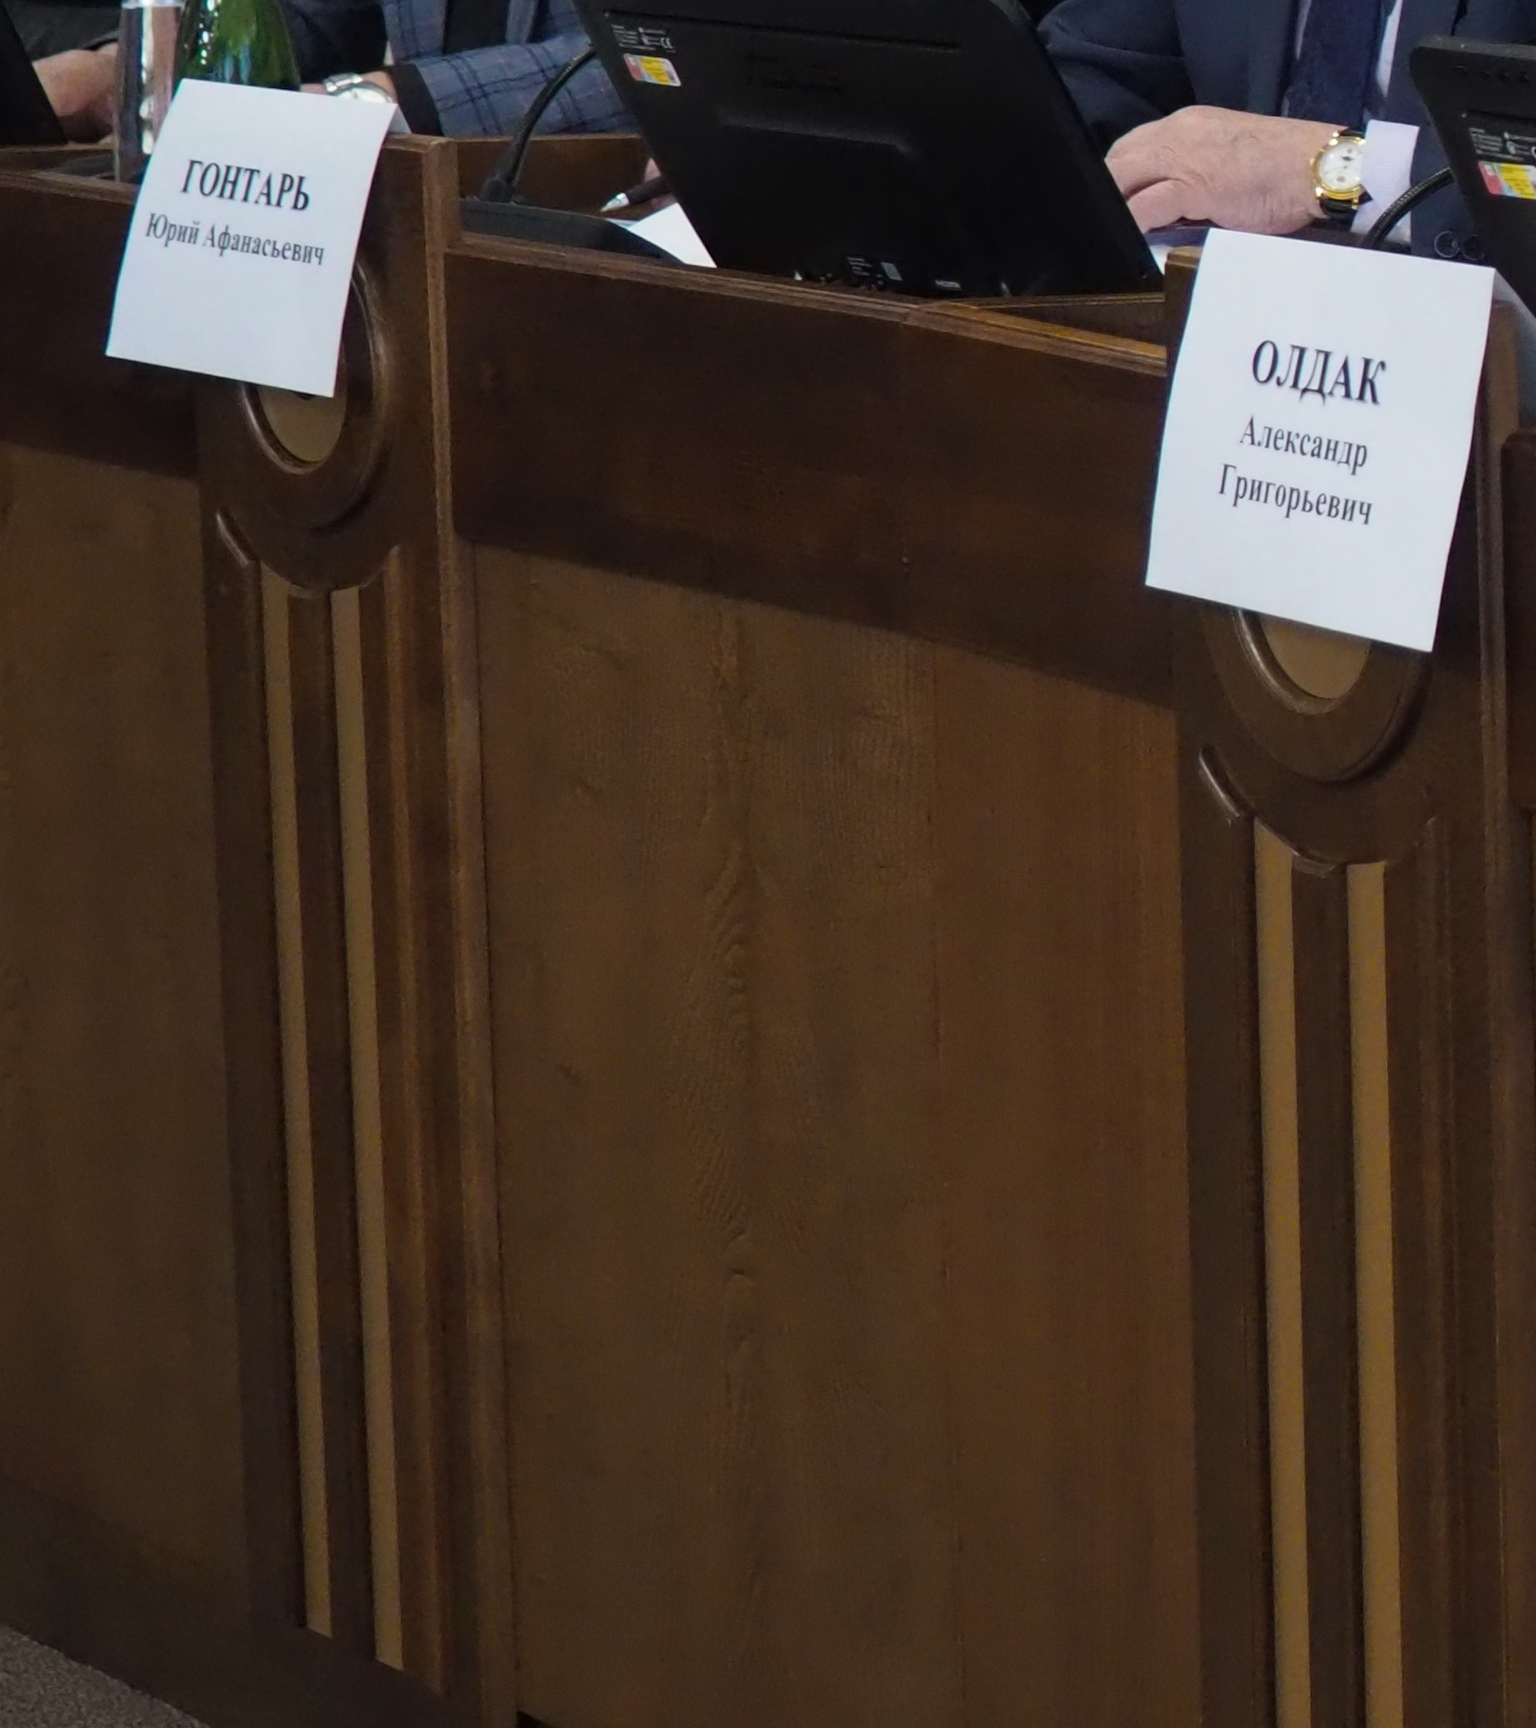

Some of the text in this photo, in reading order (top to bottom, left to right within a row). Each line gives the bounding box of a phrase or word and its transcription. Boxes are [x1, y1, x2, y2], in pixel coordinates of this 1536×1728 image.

[181, 159, 310, 211] ГОНТАРЬ
[146, 213, 325, 266] Юрий Афанасьевич
[1252, 339, 1386, 406] ОЛДАК
[1239, 416, 1368, 476] Александр
[1218, 463, 1373, 526] Григорьевич
